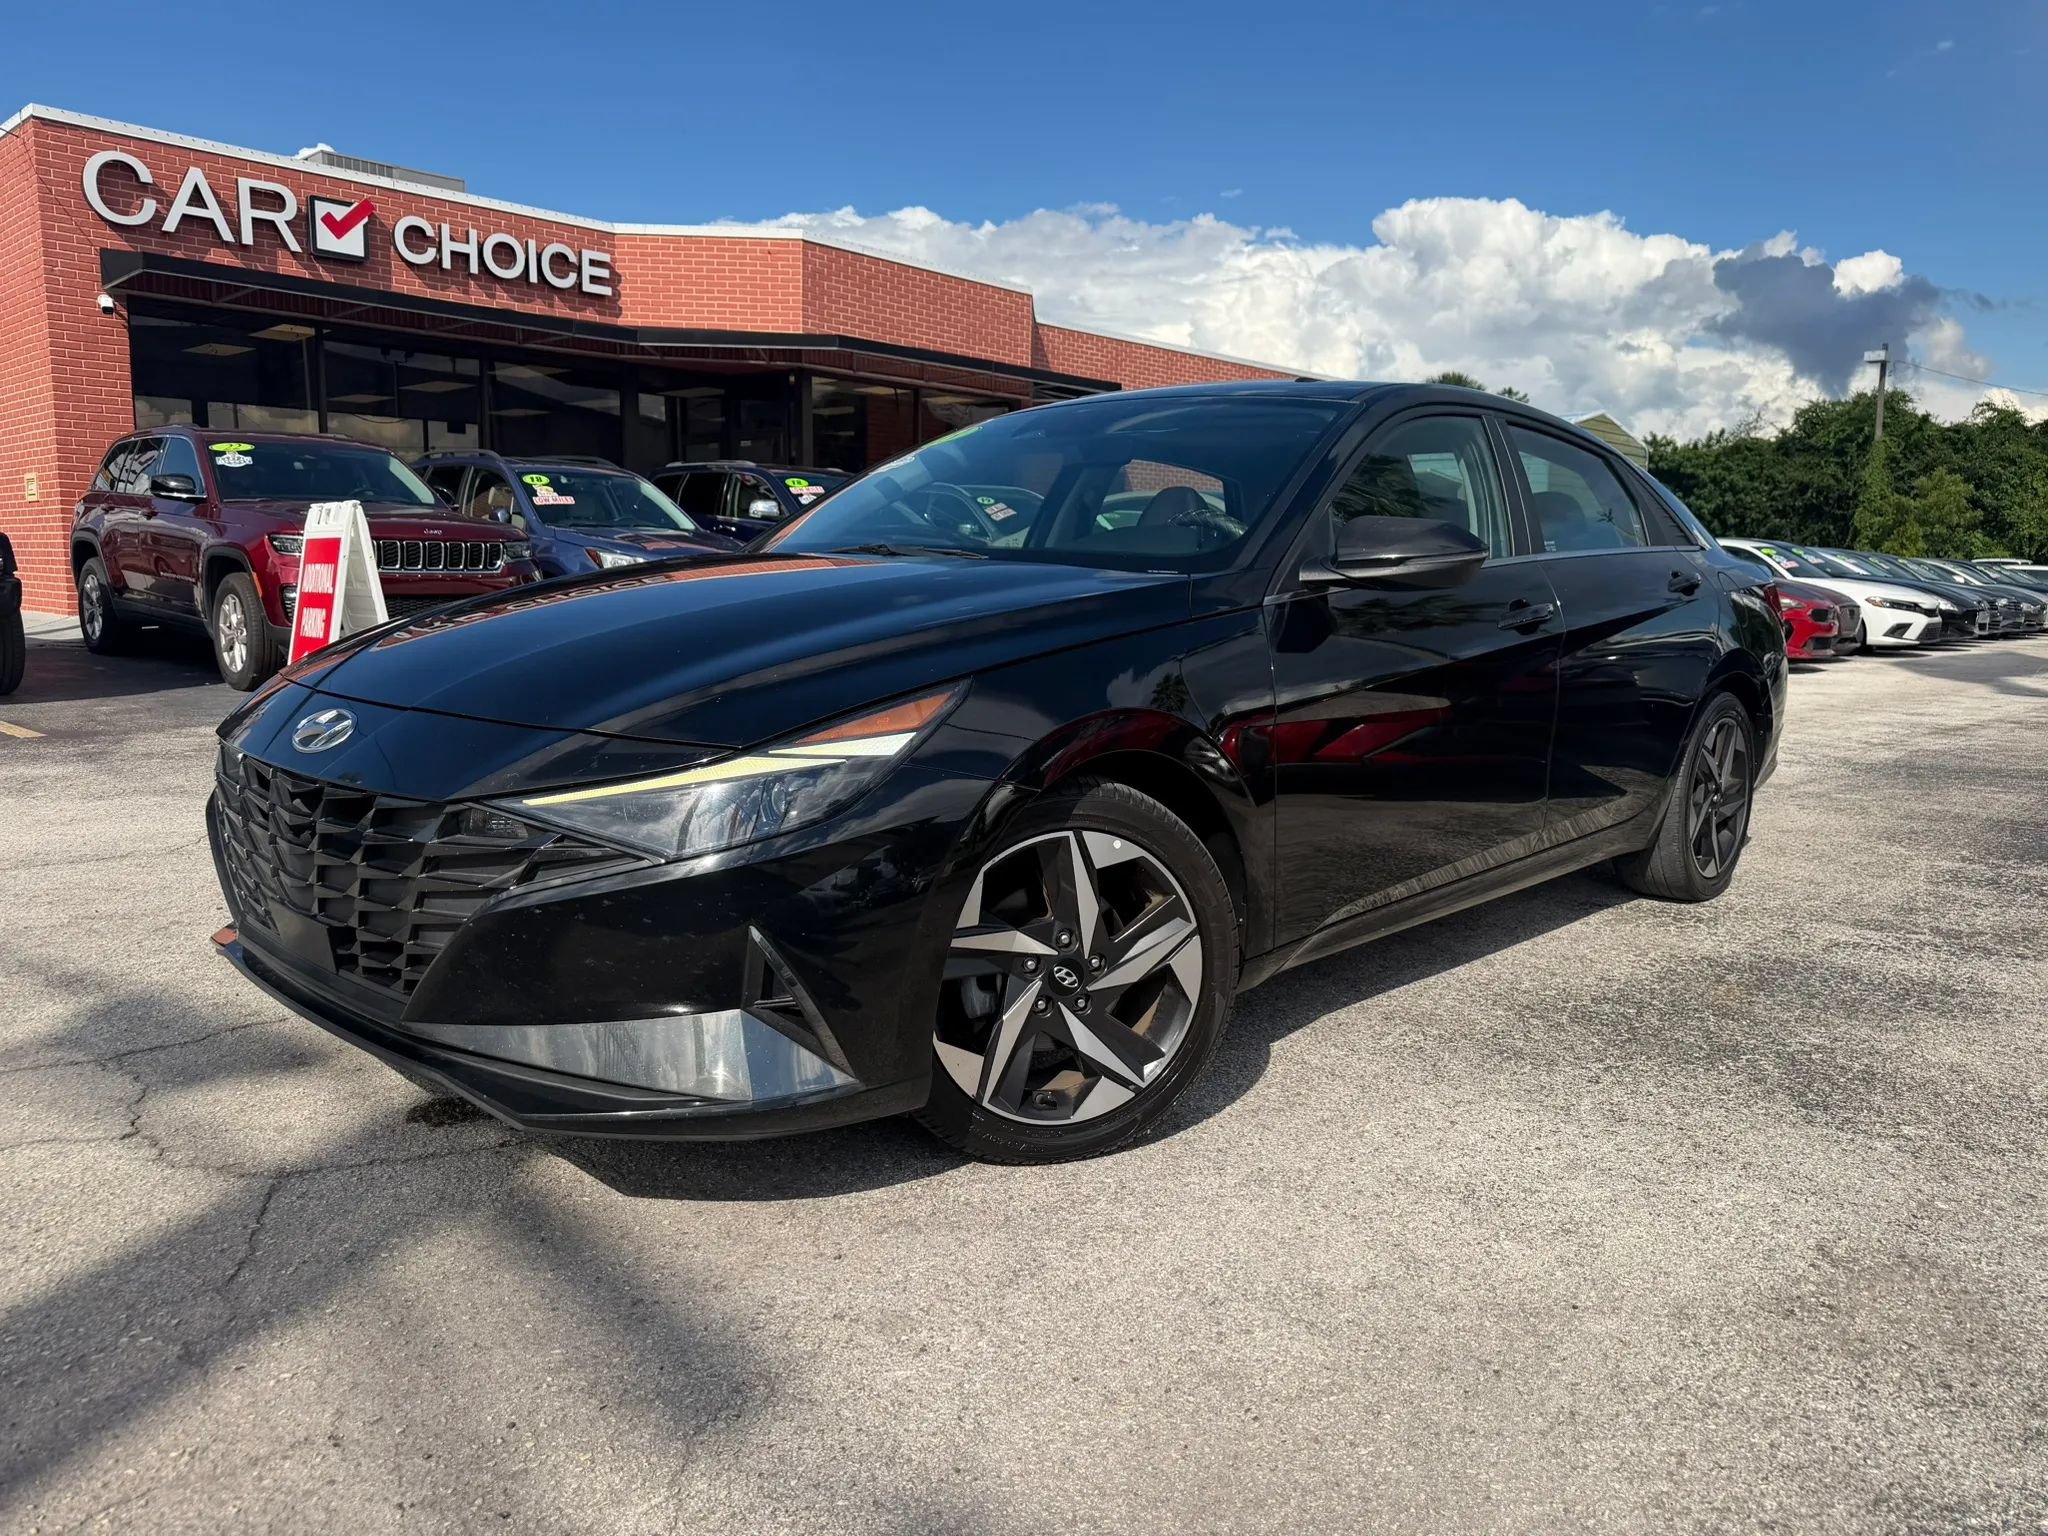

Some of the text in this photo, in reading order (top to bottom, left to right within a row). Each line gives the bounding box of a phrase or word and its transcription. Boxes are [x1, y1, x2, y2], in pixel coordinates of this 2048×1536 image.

[82, 150, 613, 296] CAR CHOICE
[535, 496, 550, 505] LOW
[300, 606, 327, 640] PARKING
